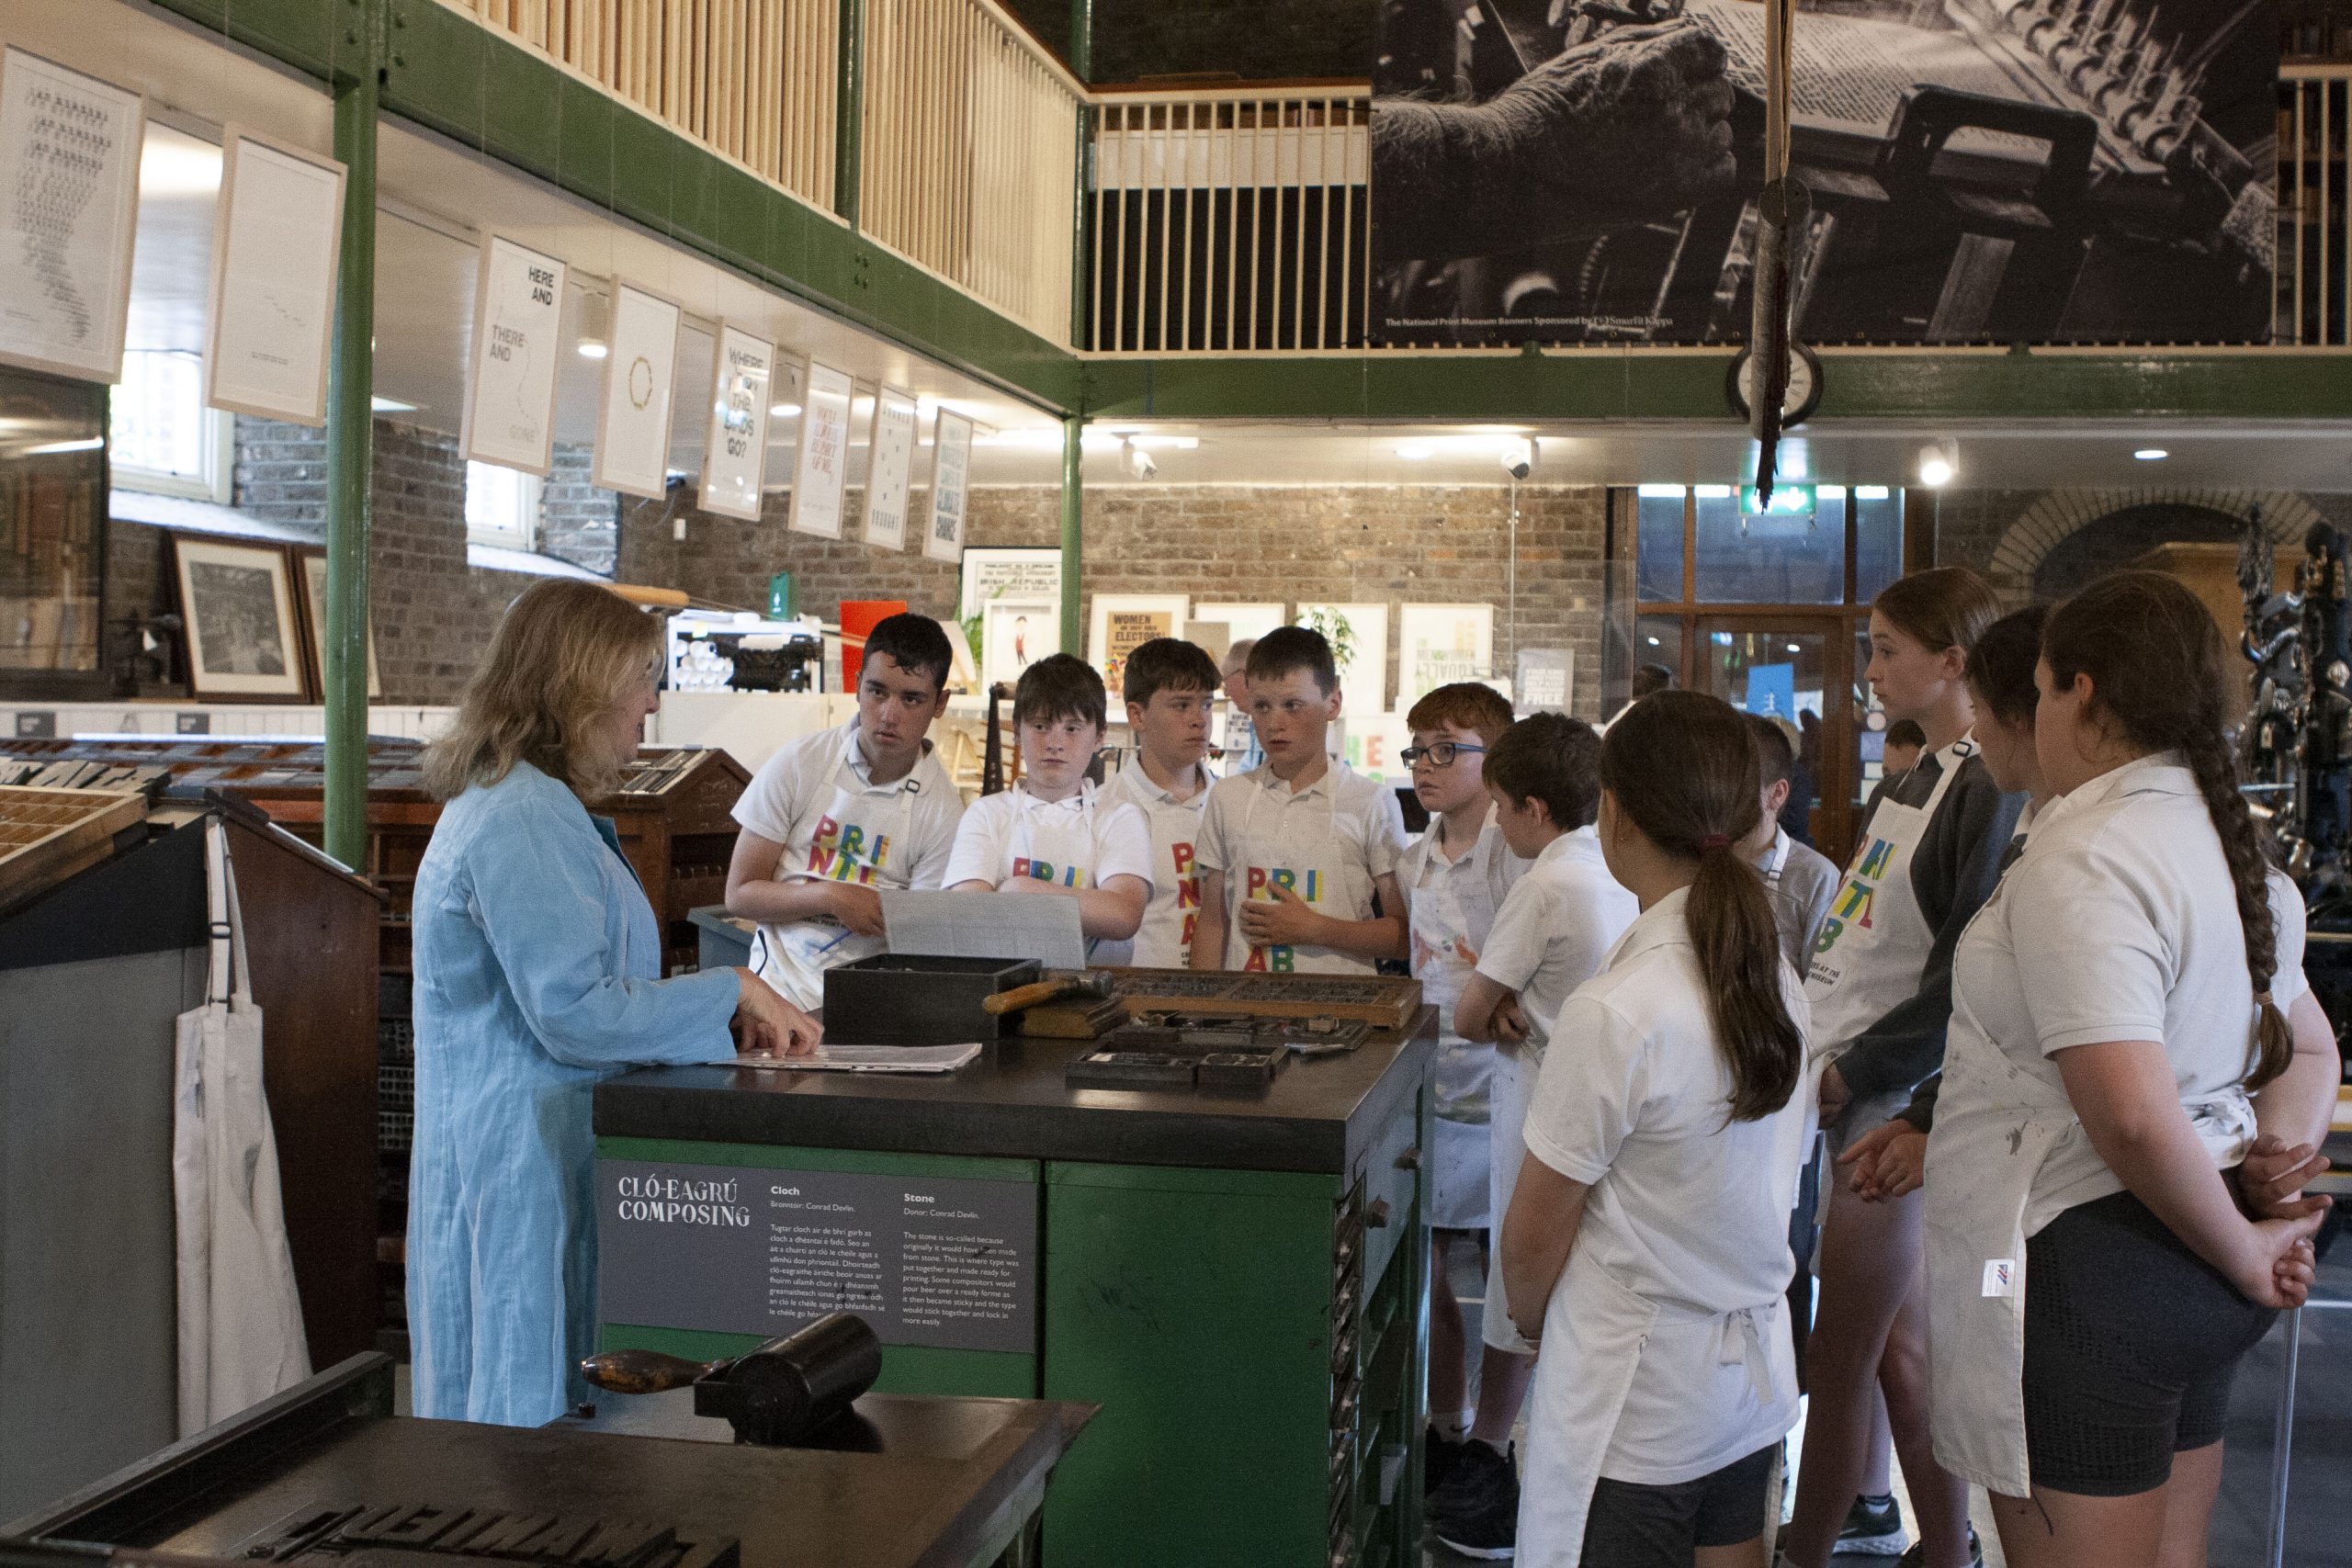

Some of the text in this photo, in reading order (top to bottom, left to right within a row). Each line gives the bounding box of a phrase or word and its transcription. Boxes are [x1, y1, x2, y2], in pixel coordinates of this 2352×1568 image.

[528, 265, 554, 288] HERE
[532, 288, 552, 306] AND
[1386, 319, 1399, 327] The
[1403, 318, 1438, 326] National
[1535, 316, 1578, 326] Sponsored
[1611, 315, 1644, 325] Smurfit
[492, 324, 524, 347] THERE
[490, 344, 512, 362] AND
[728, 437, 747, 458] GO?
[1114, 615, 1151, 625] WOMEN
[812, 814, 891, 868] PRI
[1248, 866, 1323, 903] PRI
[1244, 944, 1295, 973] AB
[618, 1173, 738, 1202] CLÓ-EAGRÚ
[771, 1186, 800, 1195] Cloch
[904, 1193, 935, 1203] Stone
[618, 1200, 751, 1227] COMPOSING
[806, 1202, 831, 1211] Conrad
[832, 1203, 855, 1212] Devlin.
[903, 1207, 979, 1219] Donor: Conrad Devlin.
[770, 1235, 788, 1243] cloch
[847, 1229, 863, 1237] gurb
[903, 1231, 917, 1240] The
[918, 1233, 937, 1241] stone
[945, 1235, 976, 1243] so-called
[977, 1235, 1004, 1245] because
[903, 1243, 933, 1252] originally
[963, 1246, 979, 1254] have
[998, 1247, 1017, 1256] made
[903, 1252, 920, 1260] from
[921, 1254, 941, 1262] stone.
[944, 1255, 957, 1263] This
[966, 1257, 988, 1265] where
[989, 1258, 1005, 1267] type
[836, 1269, 853, 1278] beoir
[902, 1264, 1011, 1278] put together and made ready for
[816, 1279, 832, 1287] chun
[902, 1274, 931, 1284] printing.
[932, 1275, 951, 1284] Some
[952, 1278, 994, 1287] compositors
[836, 1292, 844, 1301] go
[902, 1286, 919, 1294] pour
[960, 1290, 979, 1298] ready
[926, 1297, 953, 1305] became
[954, 1298, 973, 1307] sticky
[1001, 1303, 1017, 1311] type
[924, 1307, 940, 1315] stick
[942, 1308, 971, 1318] together
[972, 1310, 985, 1318] and
[986, 1311, 1001, 1319] lock
